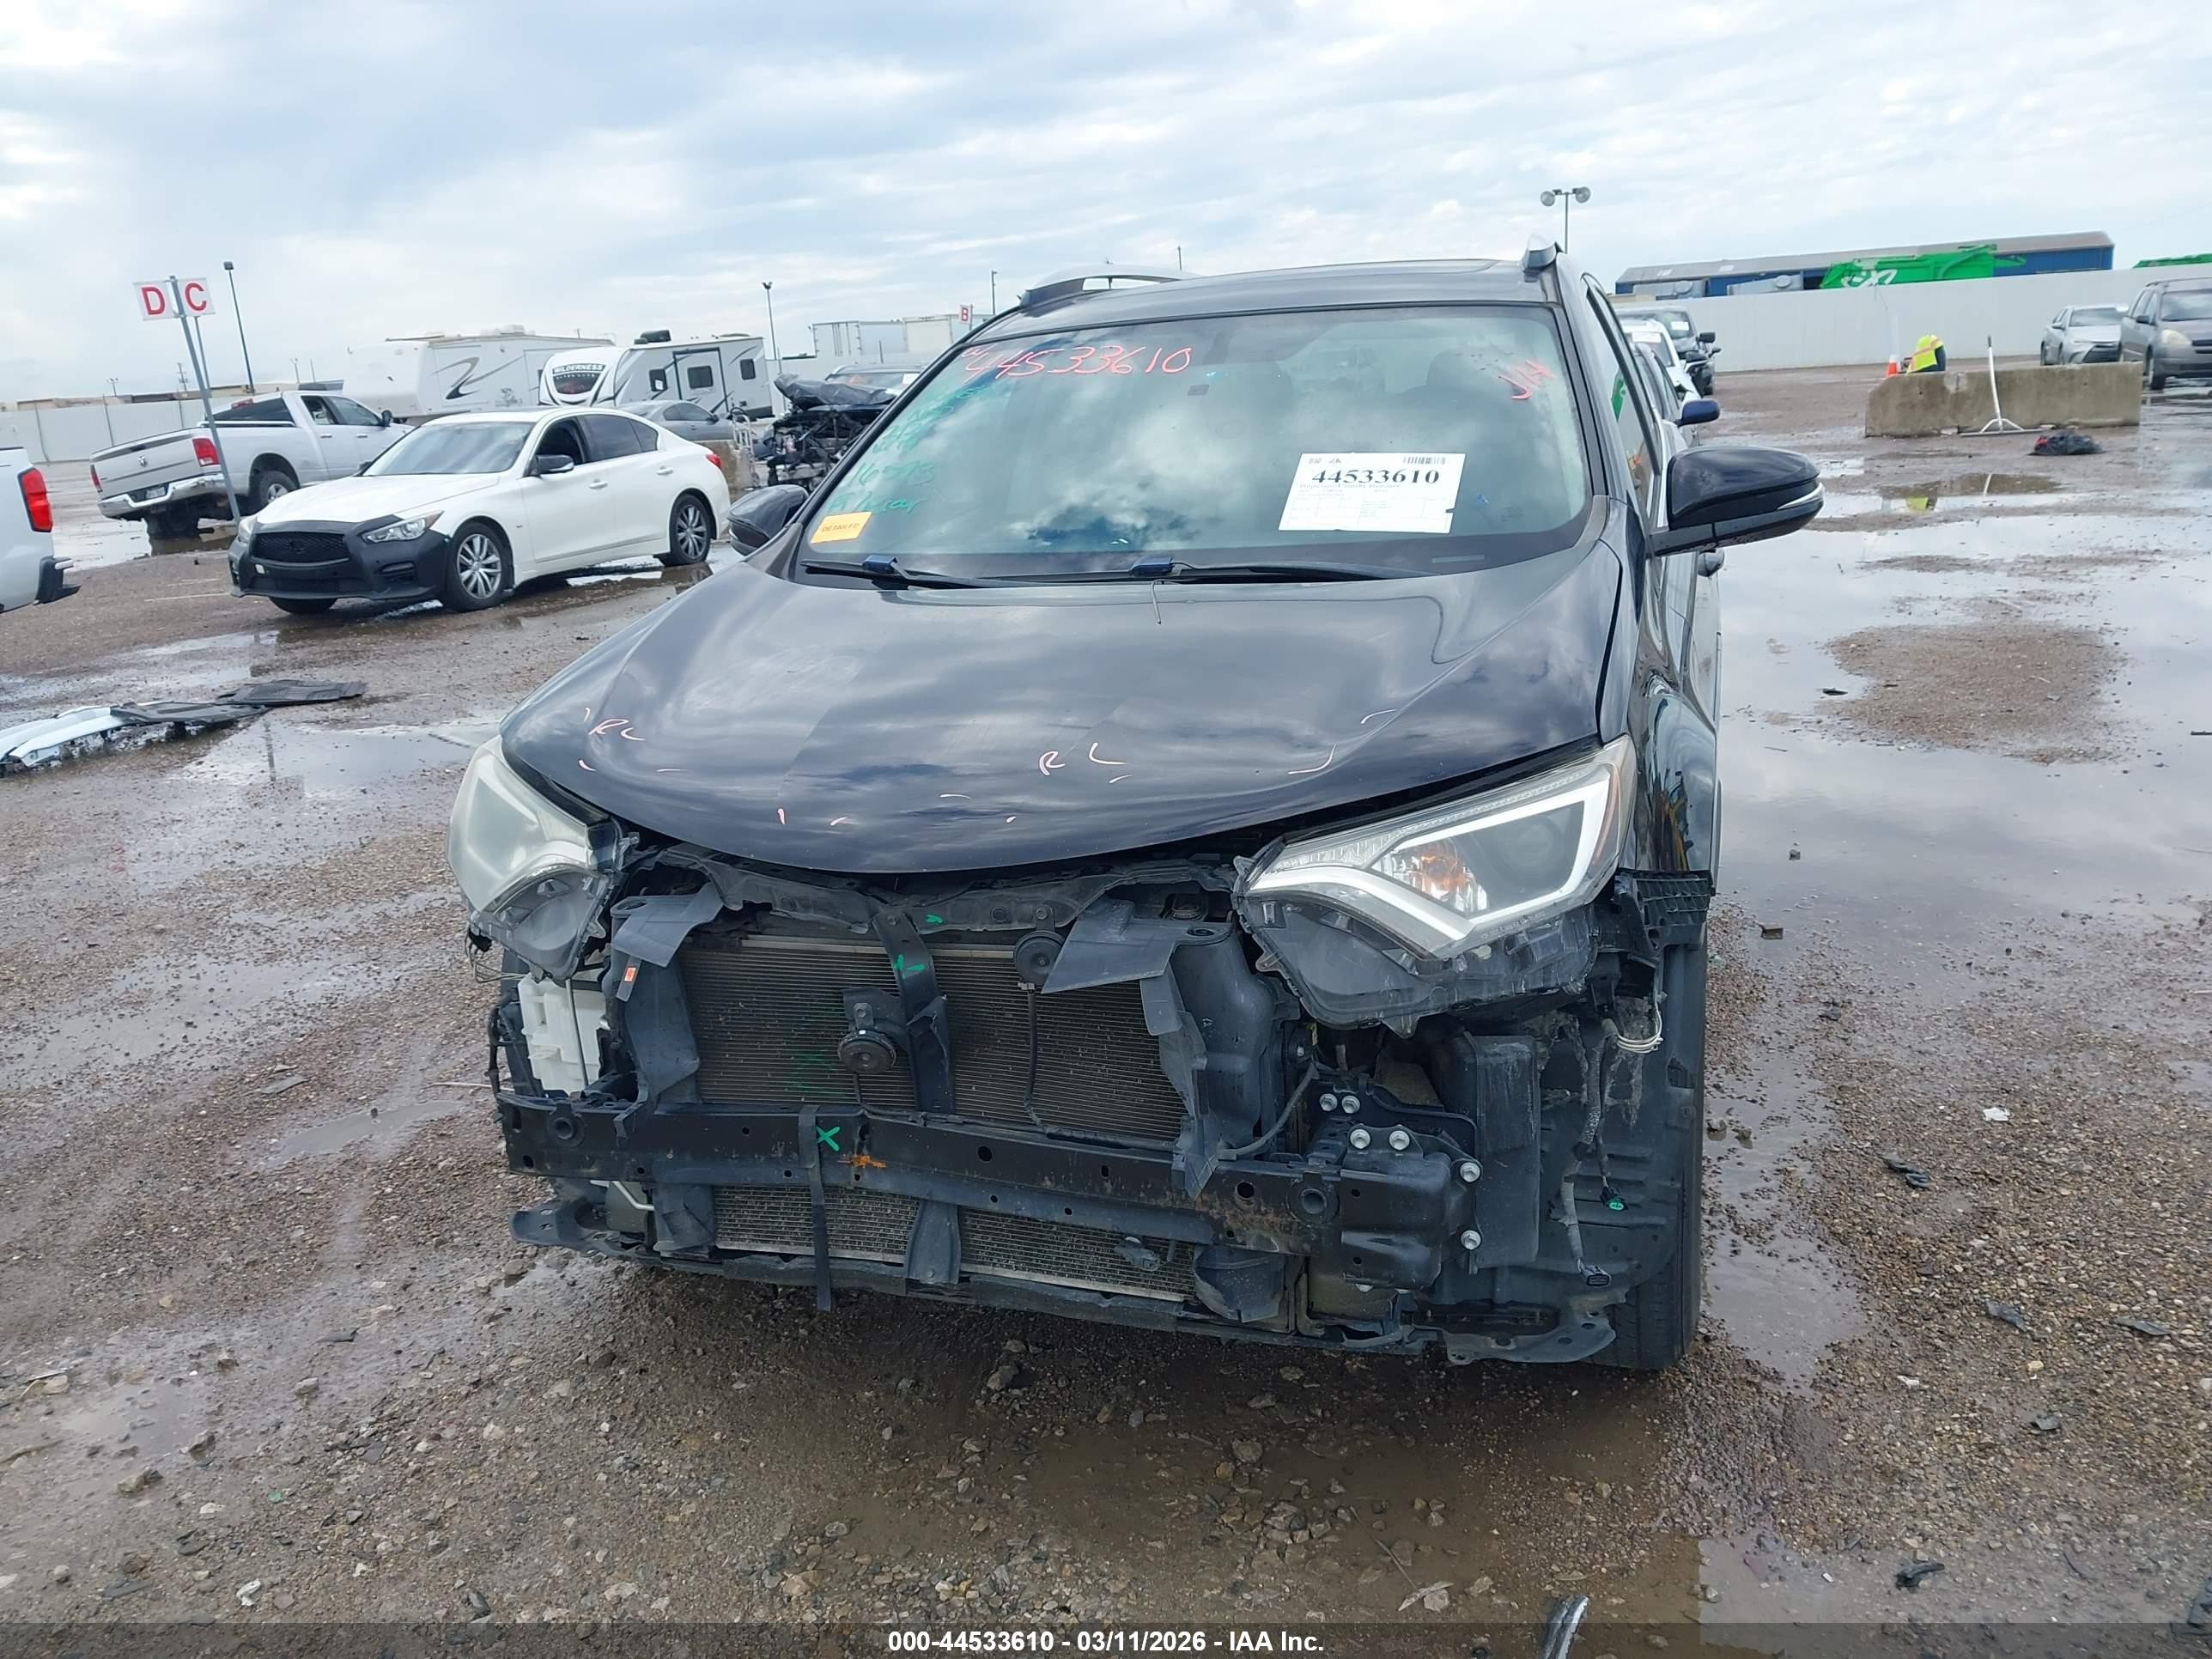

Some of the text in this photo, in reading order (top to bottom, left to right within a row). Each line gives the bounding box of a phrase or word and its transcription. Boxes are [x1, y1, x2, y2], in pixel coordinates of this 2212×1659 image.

[142, 286, 166, 315] D
[185, 283, 207, 312] C
[961, 307, 969, 322] B
[1312, 469, 1440, 484] 44533610
